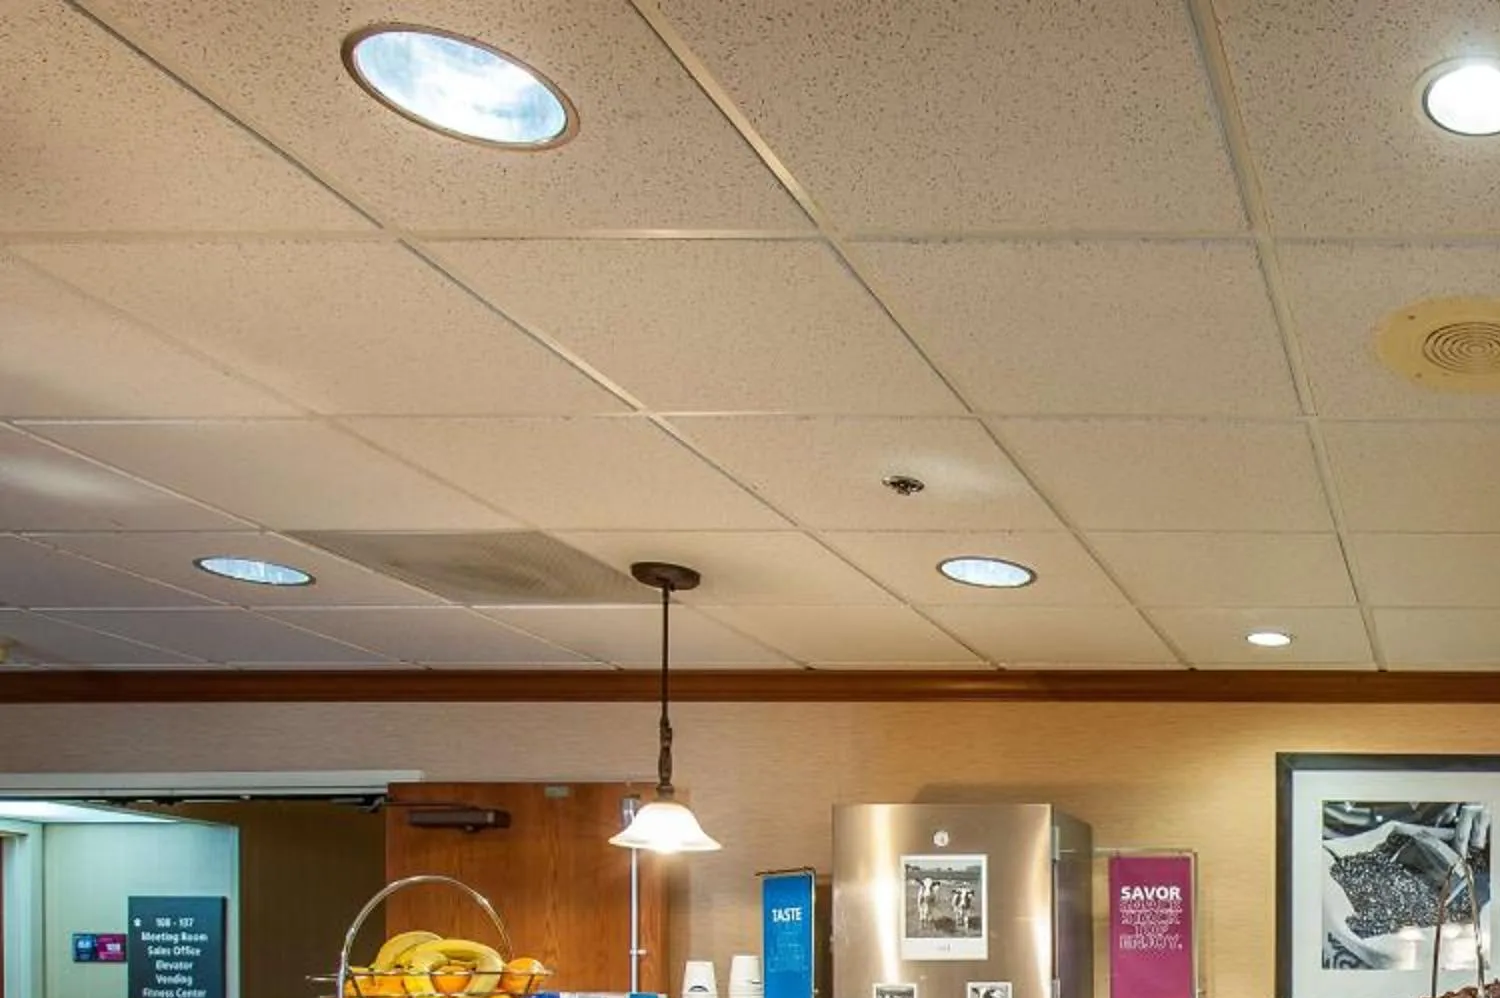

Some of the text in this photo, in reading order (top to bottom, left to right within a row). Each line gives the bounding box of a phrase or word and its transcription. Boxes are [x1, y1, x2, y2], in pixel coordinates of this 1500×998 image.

[1120, 885, 1183, 901] SAVOR
[771, 907, 803, 922] TASTE
[141, 931, 209, 944] Meeting Room
[147, 946, 201, 956] Sales Office
[155, 959, 193, 971] Elevator
[155, 974, 193, 986] Vending
[142, 988, 206, 998] Fitness Center
